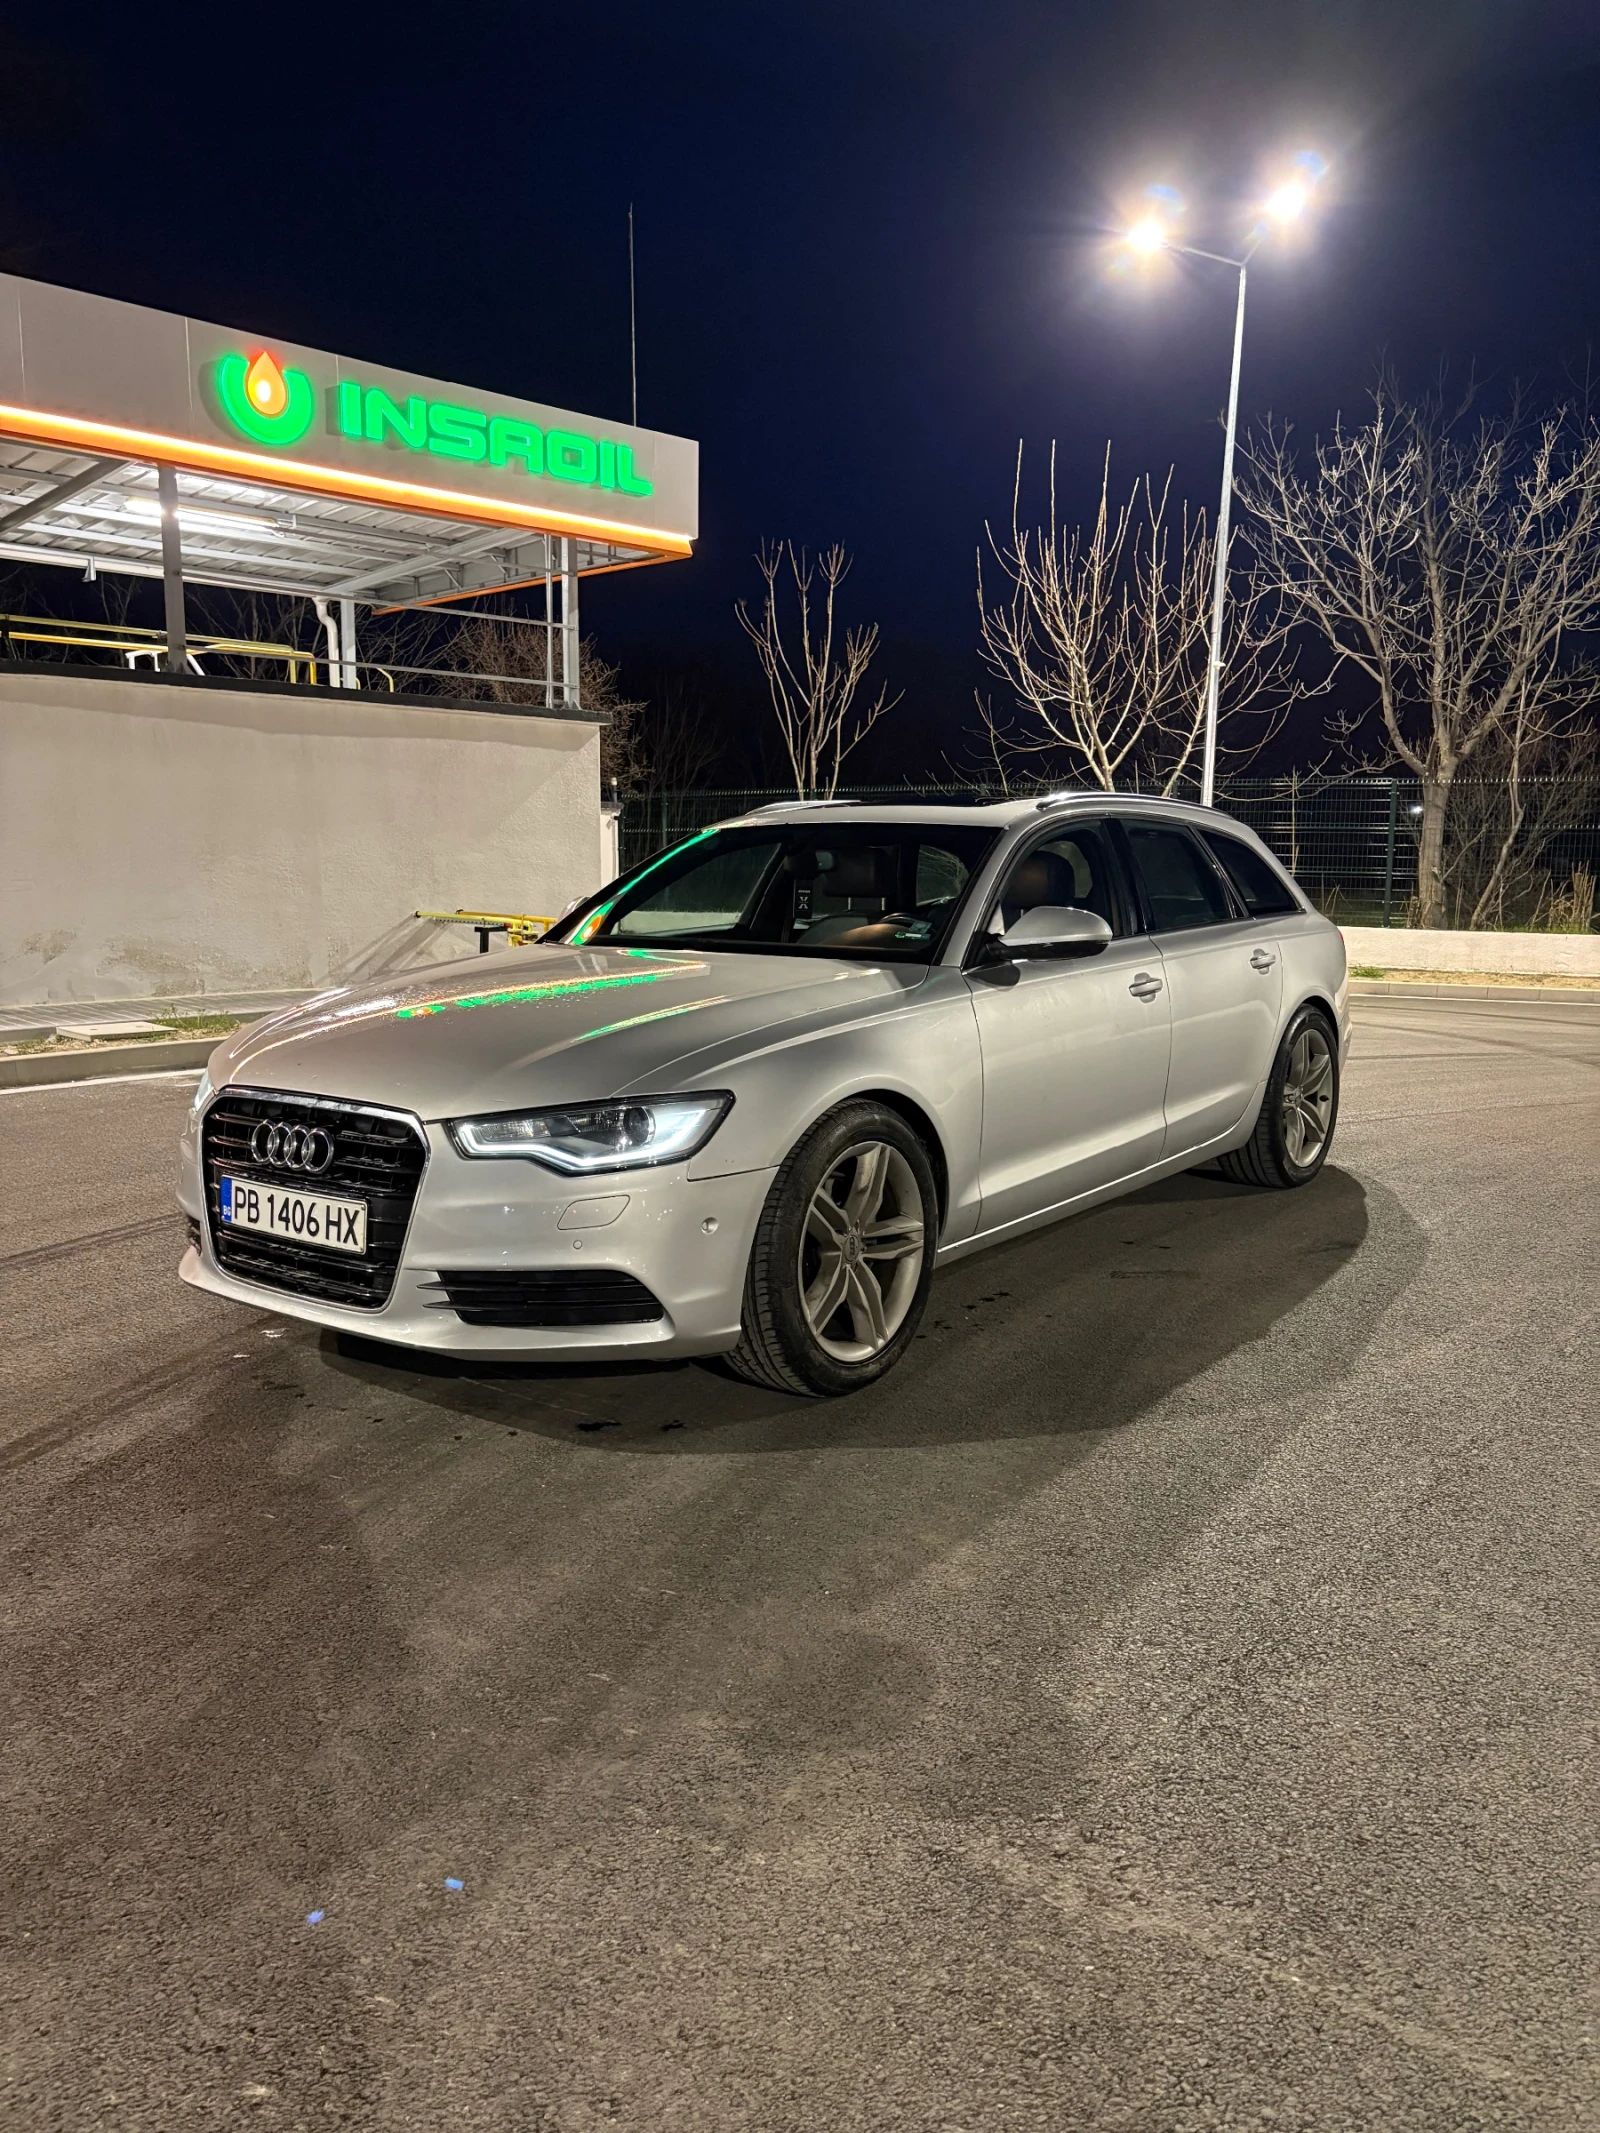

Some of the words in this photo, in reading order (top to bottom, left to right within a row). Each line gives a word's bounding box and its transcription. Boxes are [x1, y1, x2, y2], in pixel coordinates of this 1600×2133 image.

[339, 381, 653, 497] INSAOIL
[235, 1185, 260, 1224] PB
[267, 1193, 320, 1237] 1406
[325, 1204, 360, 1246] HX
